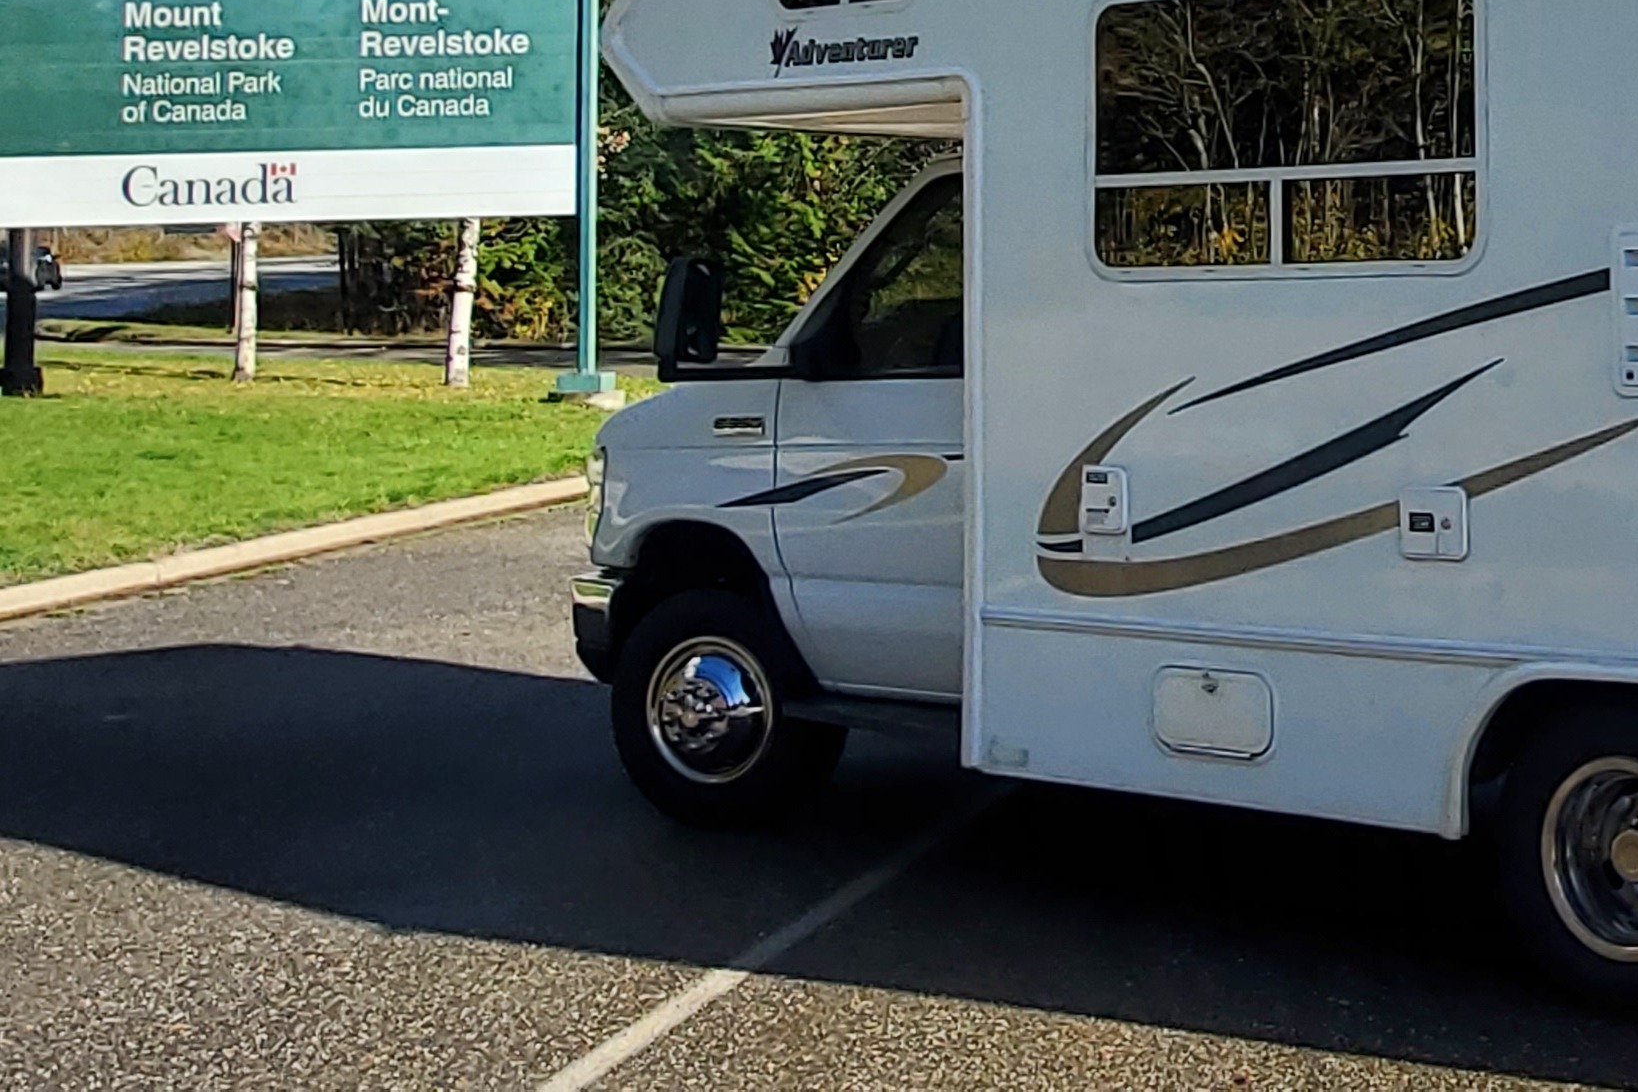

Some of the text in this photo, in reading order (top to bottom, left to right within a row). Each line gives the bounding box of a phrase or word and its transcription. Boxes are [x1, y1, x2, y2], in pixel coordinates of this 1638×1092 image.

[124, 0, 223, 28] Mount
[122, 32, 296, 61] Revelstoke
[360, 27, 531, 57] Revelstoke
[784, 35, 919, 68] Adventurer
[122, 70, 282, 97] National Park
[359, 65, 513, 92] Parc national
[121, 98, 247, 123] of Canada
[358, 92, 490, 118] du Canada
[120, 162, 298, 208] Canada
